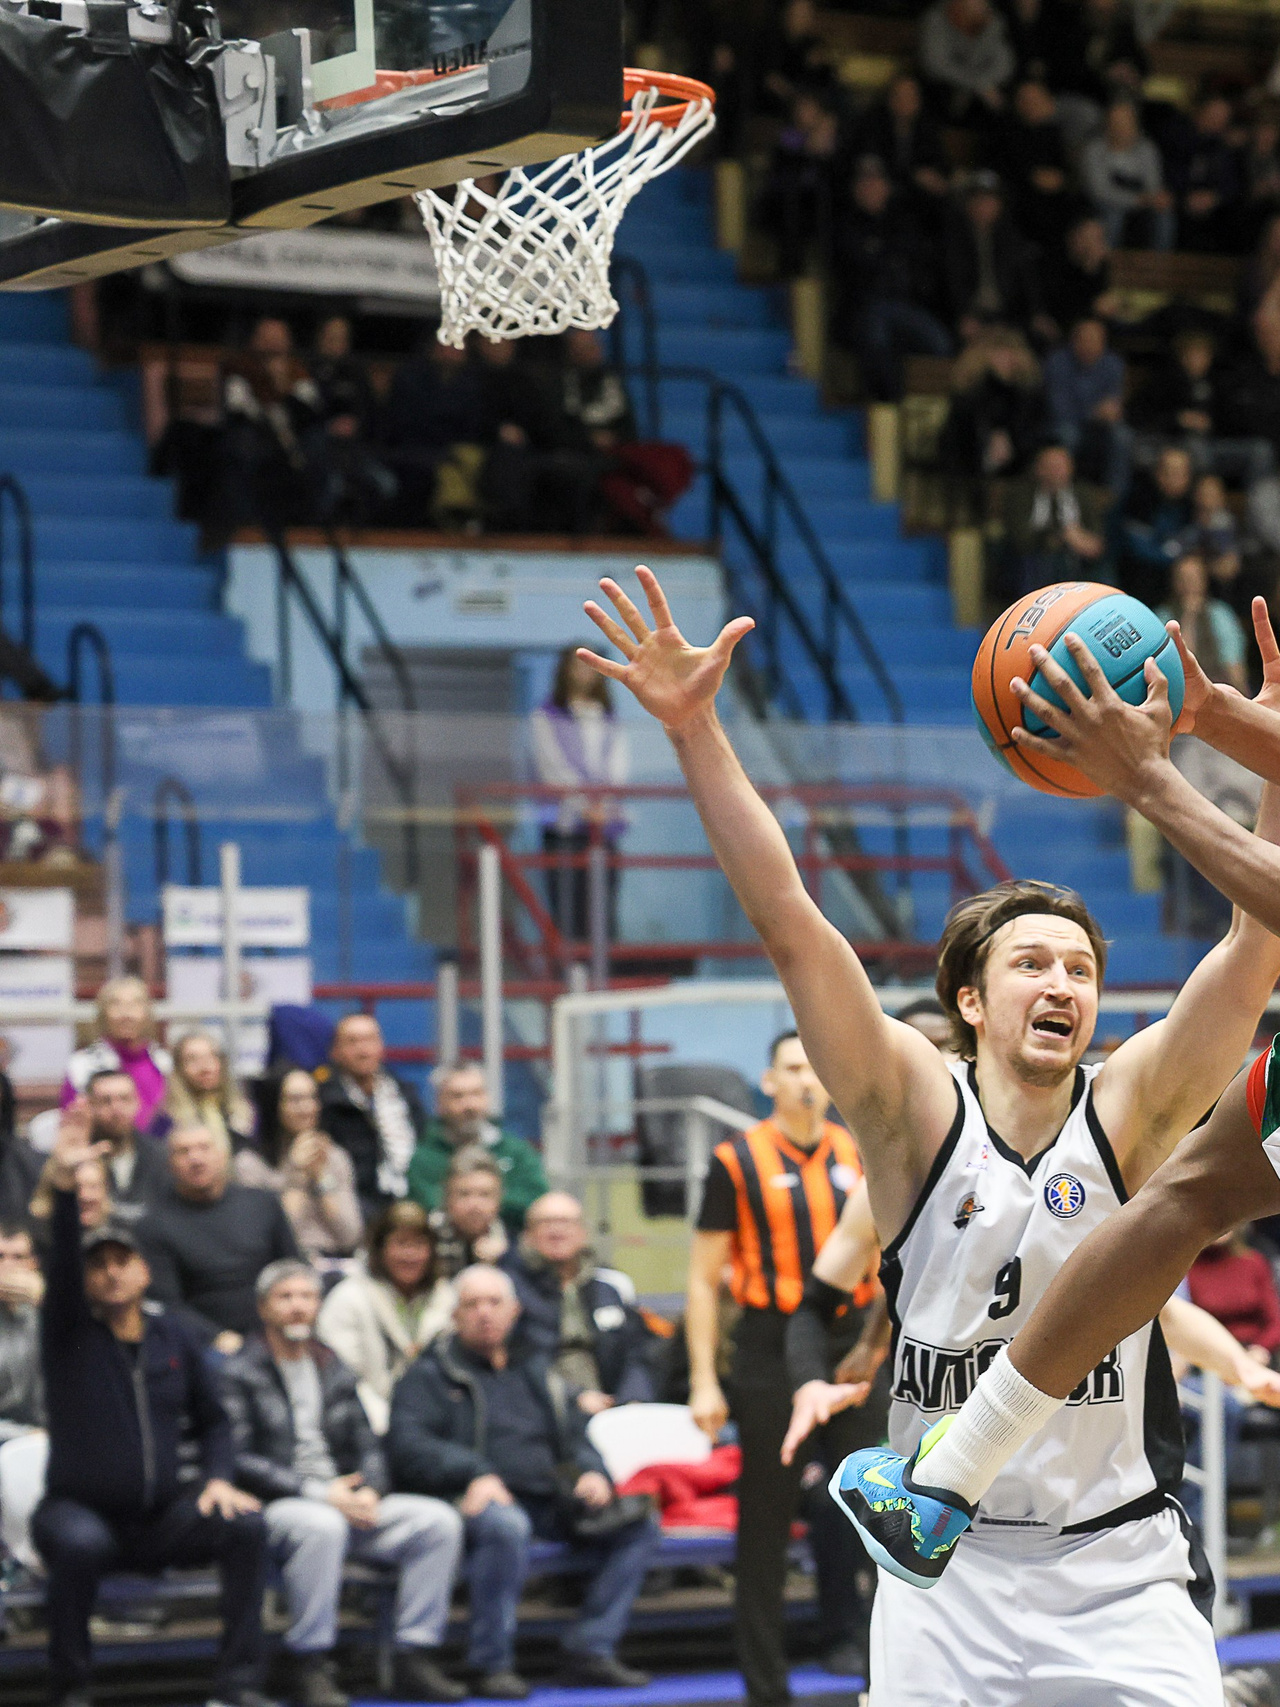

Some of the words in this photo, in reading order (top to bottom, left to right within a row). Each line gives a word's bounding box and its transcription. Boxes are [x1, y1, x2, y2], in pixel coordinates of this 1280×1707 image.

[1102, 621, 1143, 660] FIBA
[988, 1256, 1022, 1321] 9
[892, 1336, 1124, 1413] AVTR
